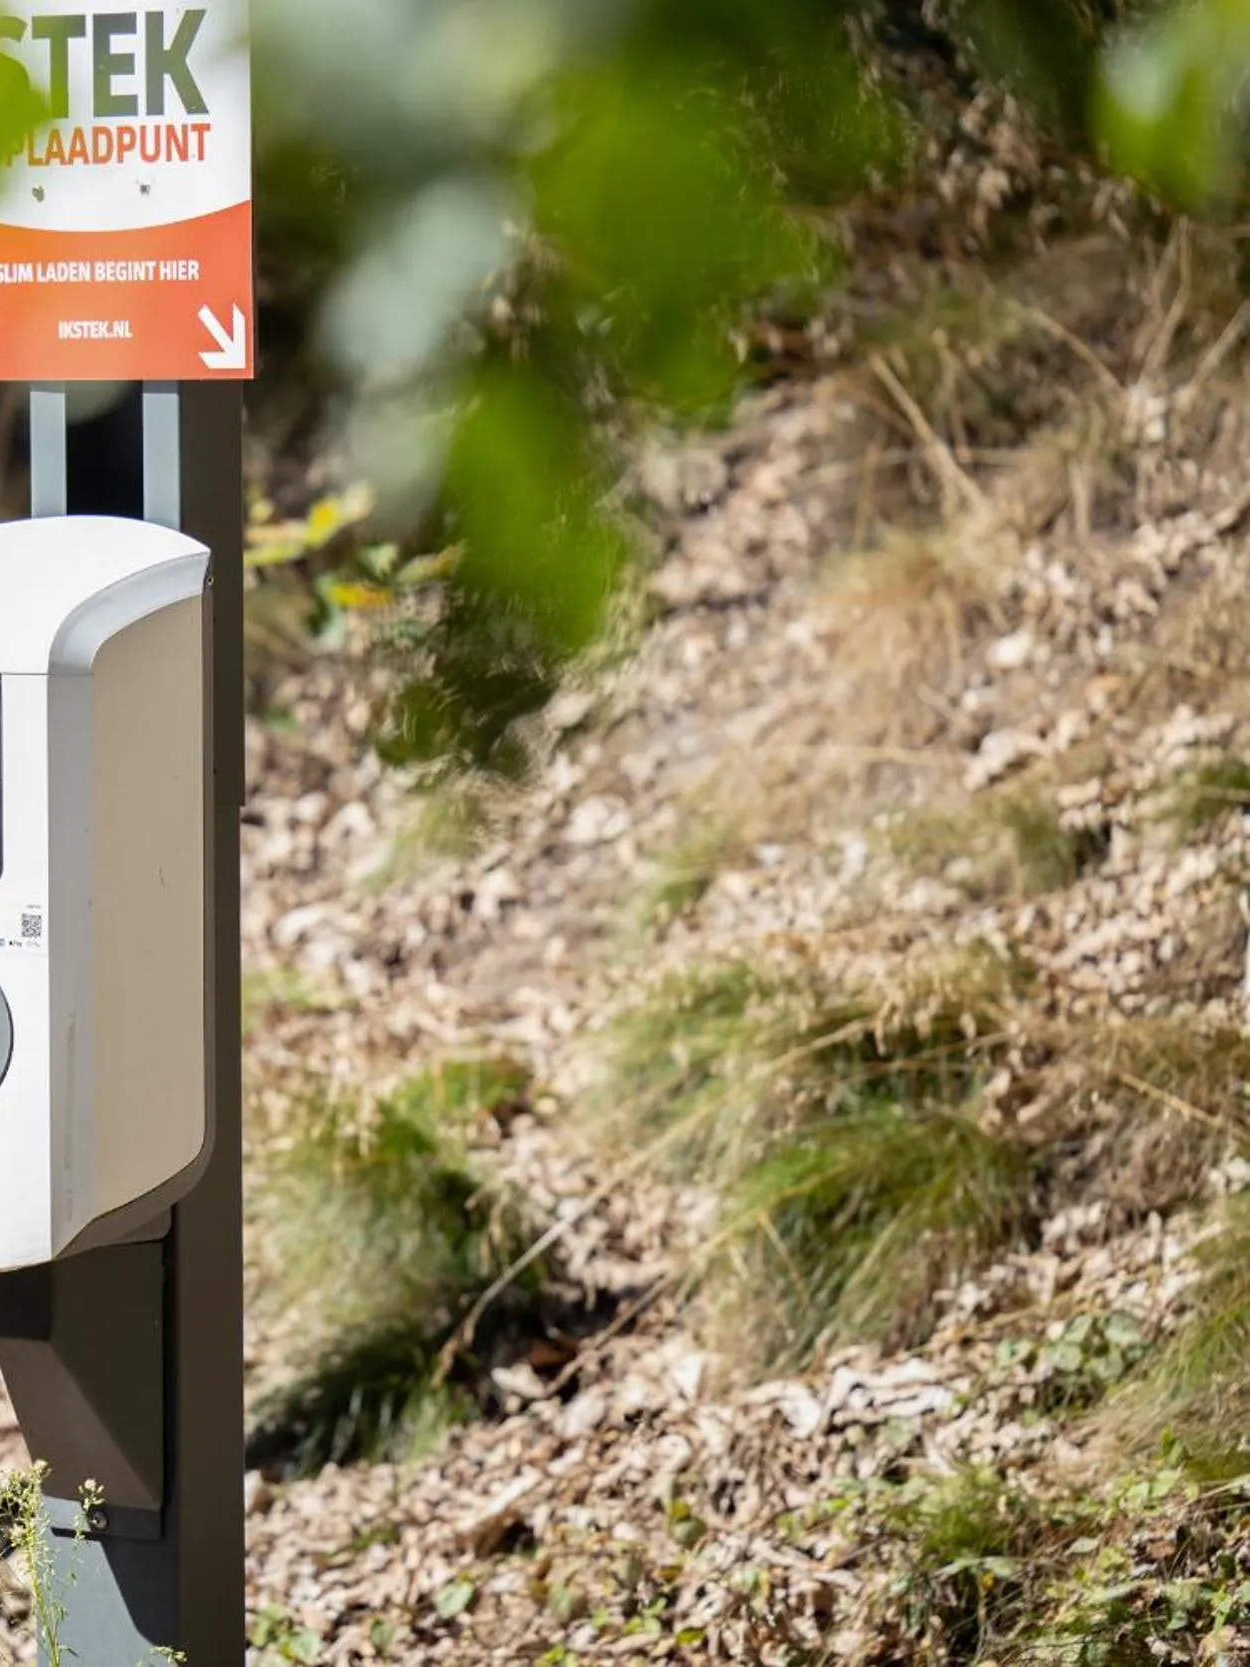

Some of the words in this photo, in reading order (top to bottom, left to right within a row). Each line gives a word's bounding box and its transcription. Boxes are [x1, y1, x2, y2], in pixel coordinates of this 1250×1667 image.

[37, 261, 91, 283] LADEN
[94, 260, 156, 282] BEGINT
[159, 259, 200, 281] HIER
[58, 319, 133, 339] IKSTEK.NL
